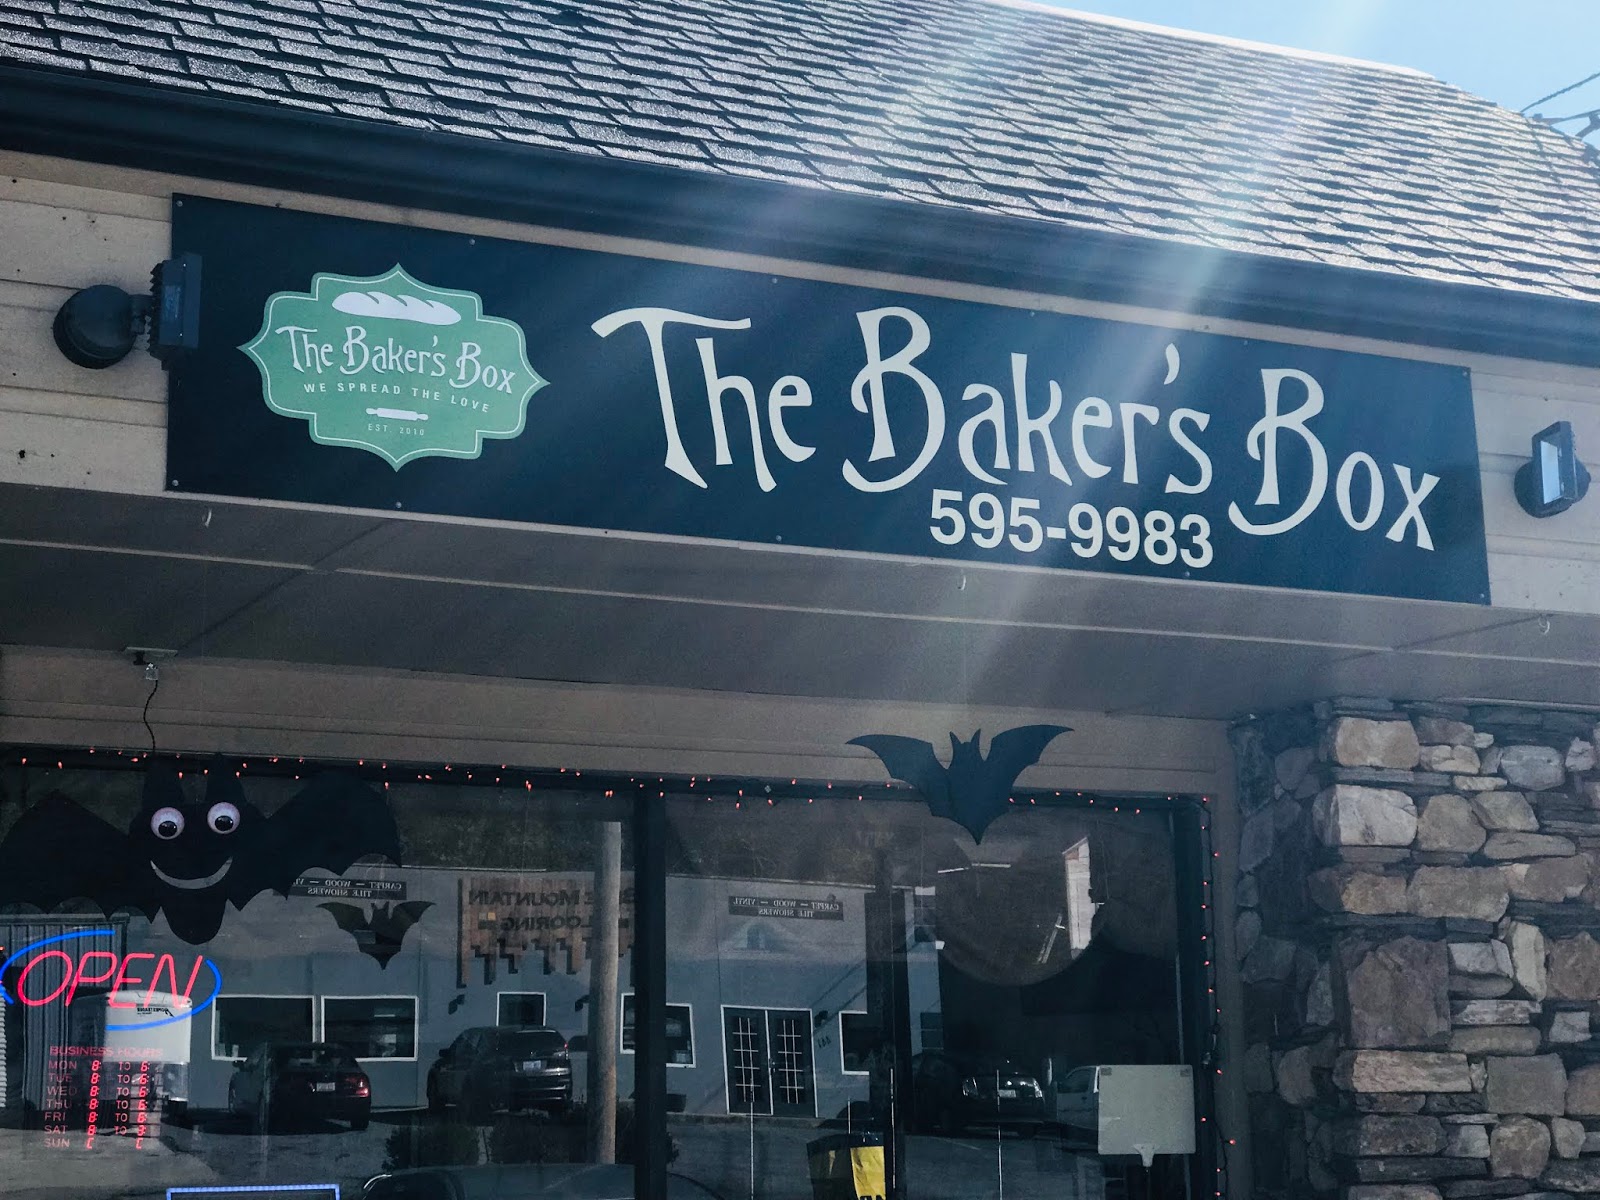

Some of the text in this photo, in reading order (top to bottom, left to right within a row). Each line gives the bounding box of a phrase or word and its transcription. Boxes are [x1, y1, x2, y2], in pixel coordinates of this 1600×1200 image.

[275, 325, 516, 394] The Baker's Box
[304, 382, 490, 413] WE SPREAD THE LOVE
[368, 423, 425, 436] EST. 2010
[591, 306, 1440, 551] The Baker's Box
[929, 488, 1214, 568] 595-9983
[17, 950, 204, 1009] OPEN
[49, 1045, 114, 1056] BUSINESS
[48, 1060, 77, 1069] MON
[118, 1061, 131, 1071] TO
[48, 1073, 73, 1083] TUE
[117, 1074, 130, 1084] TO
[47, 1086, 77, 1095] WED
[116, 1087, 130, 1096] TO
[46, 1098, 72, 1108] THU
[116, 1100, 128, 1109] TO
[44, 1111, 66, 1121] FRI
[115, 1113, 128, 1122] TO
[44, 1124, 68, 1134] SAT
[114, 1125, 127, 1135] TO
[43, 1137, 70, 1148] SUN
